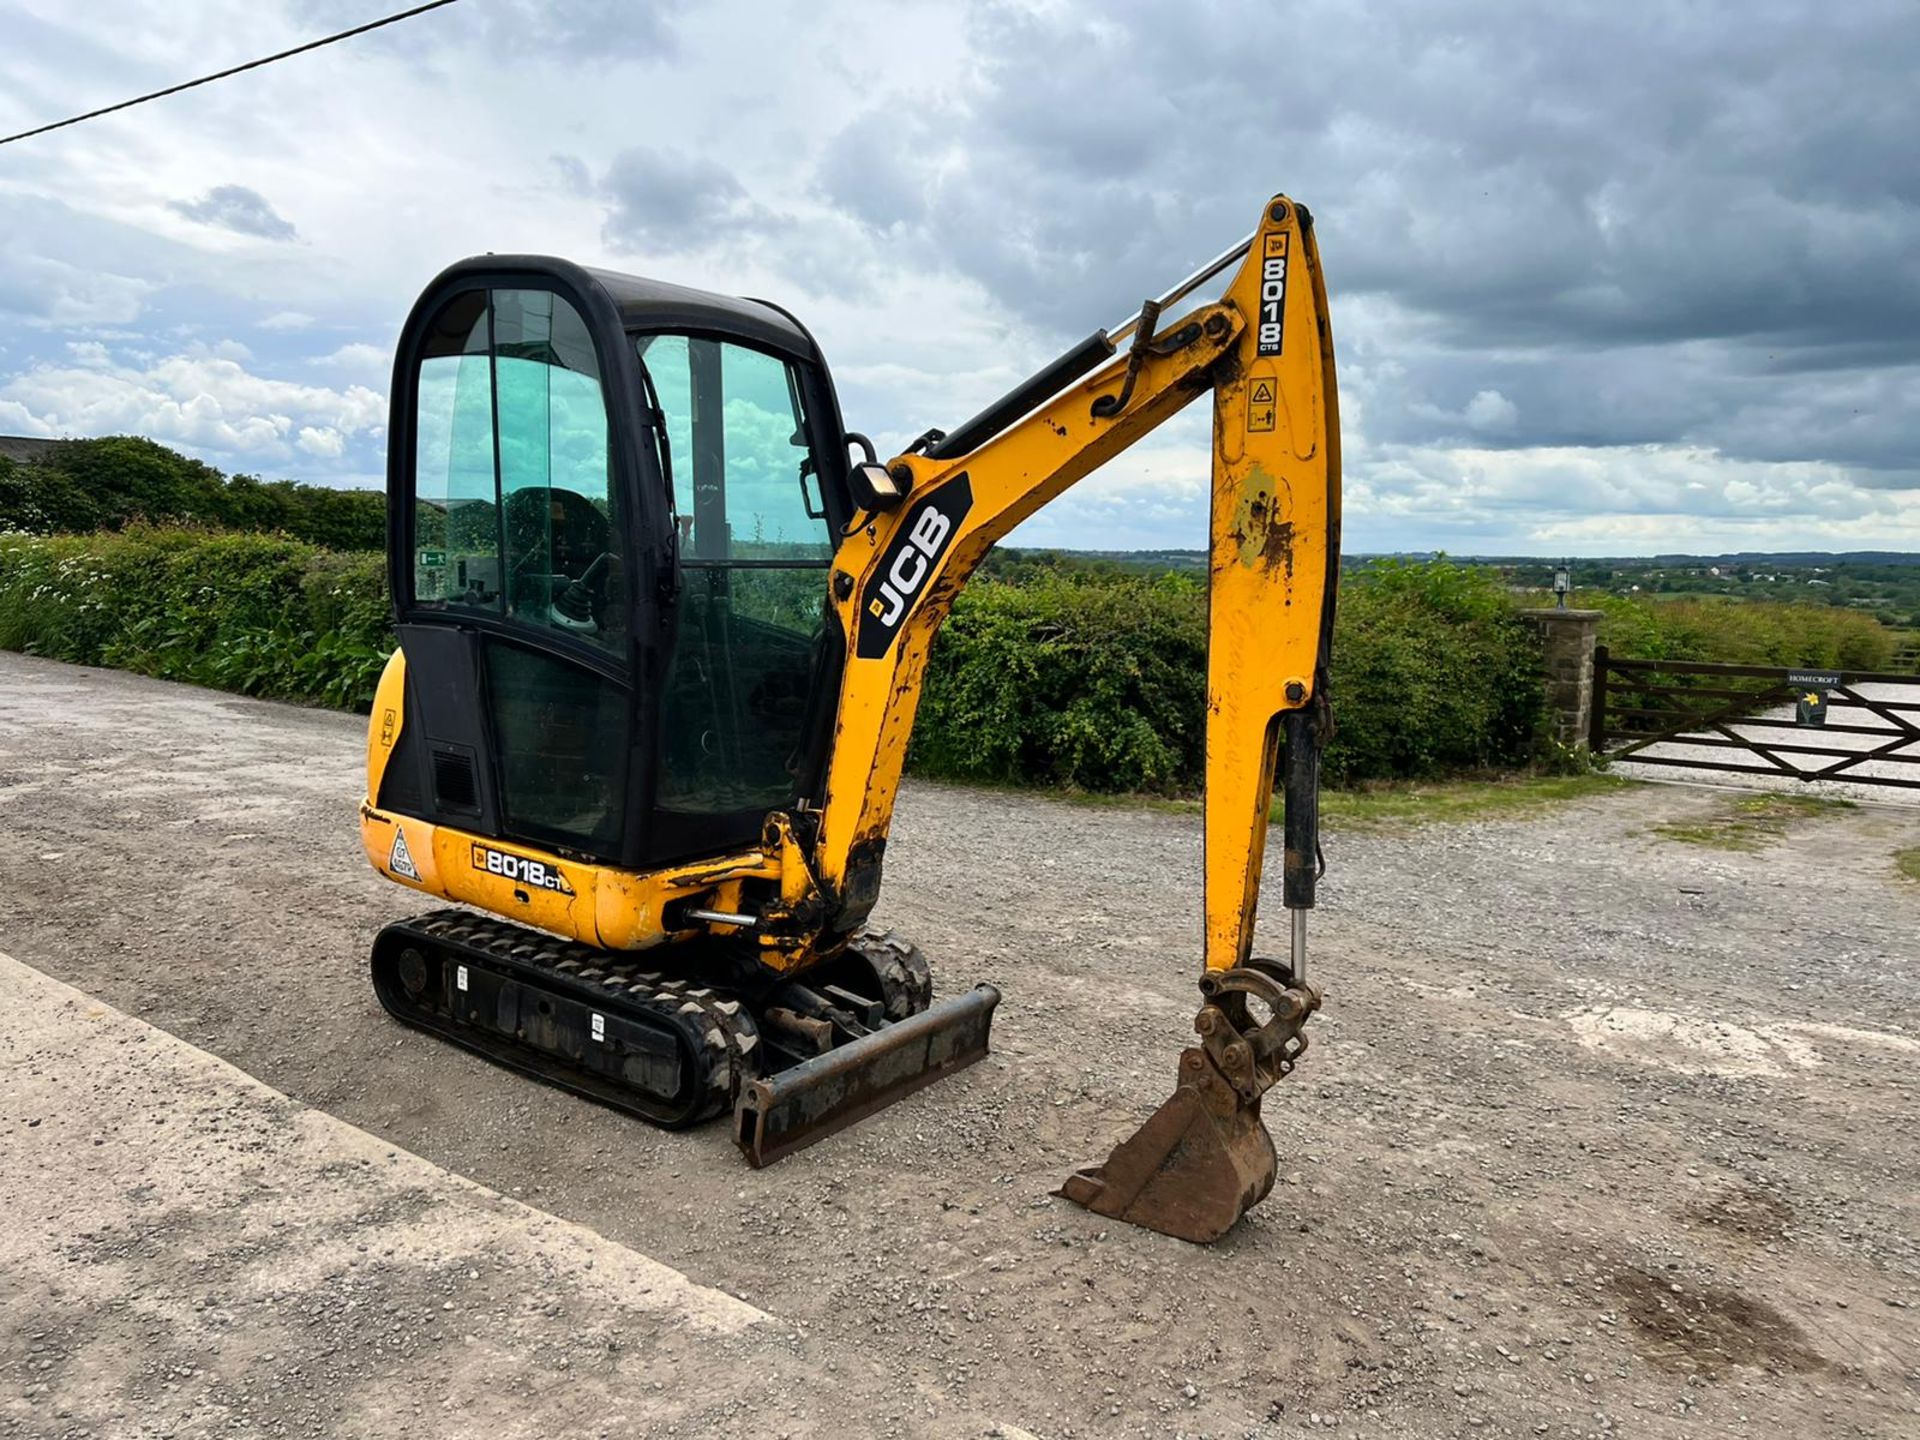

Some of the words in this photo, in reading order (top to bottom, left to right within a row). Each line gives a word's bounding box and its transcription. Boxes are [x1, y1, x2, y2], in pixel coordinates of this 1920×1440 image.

[1260, 259, 1285, 343] 8018
[879, 506, 951, 627] JCB
[1789, 675, 1839, 684] HOMECROFT
